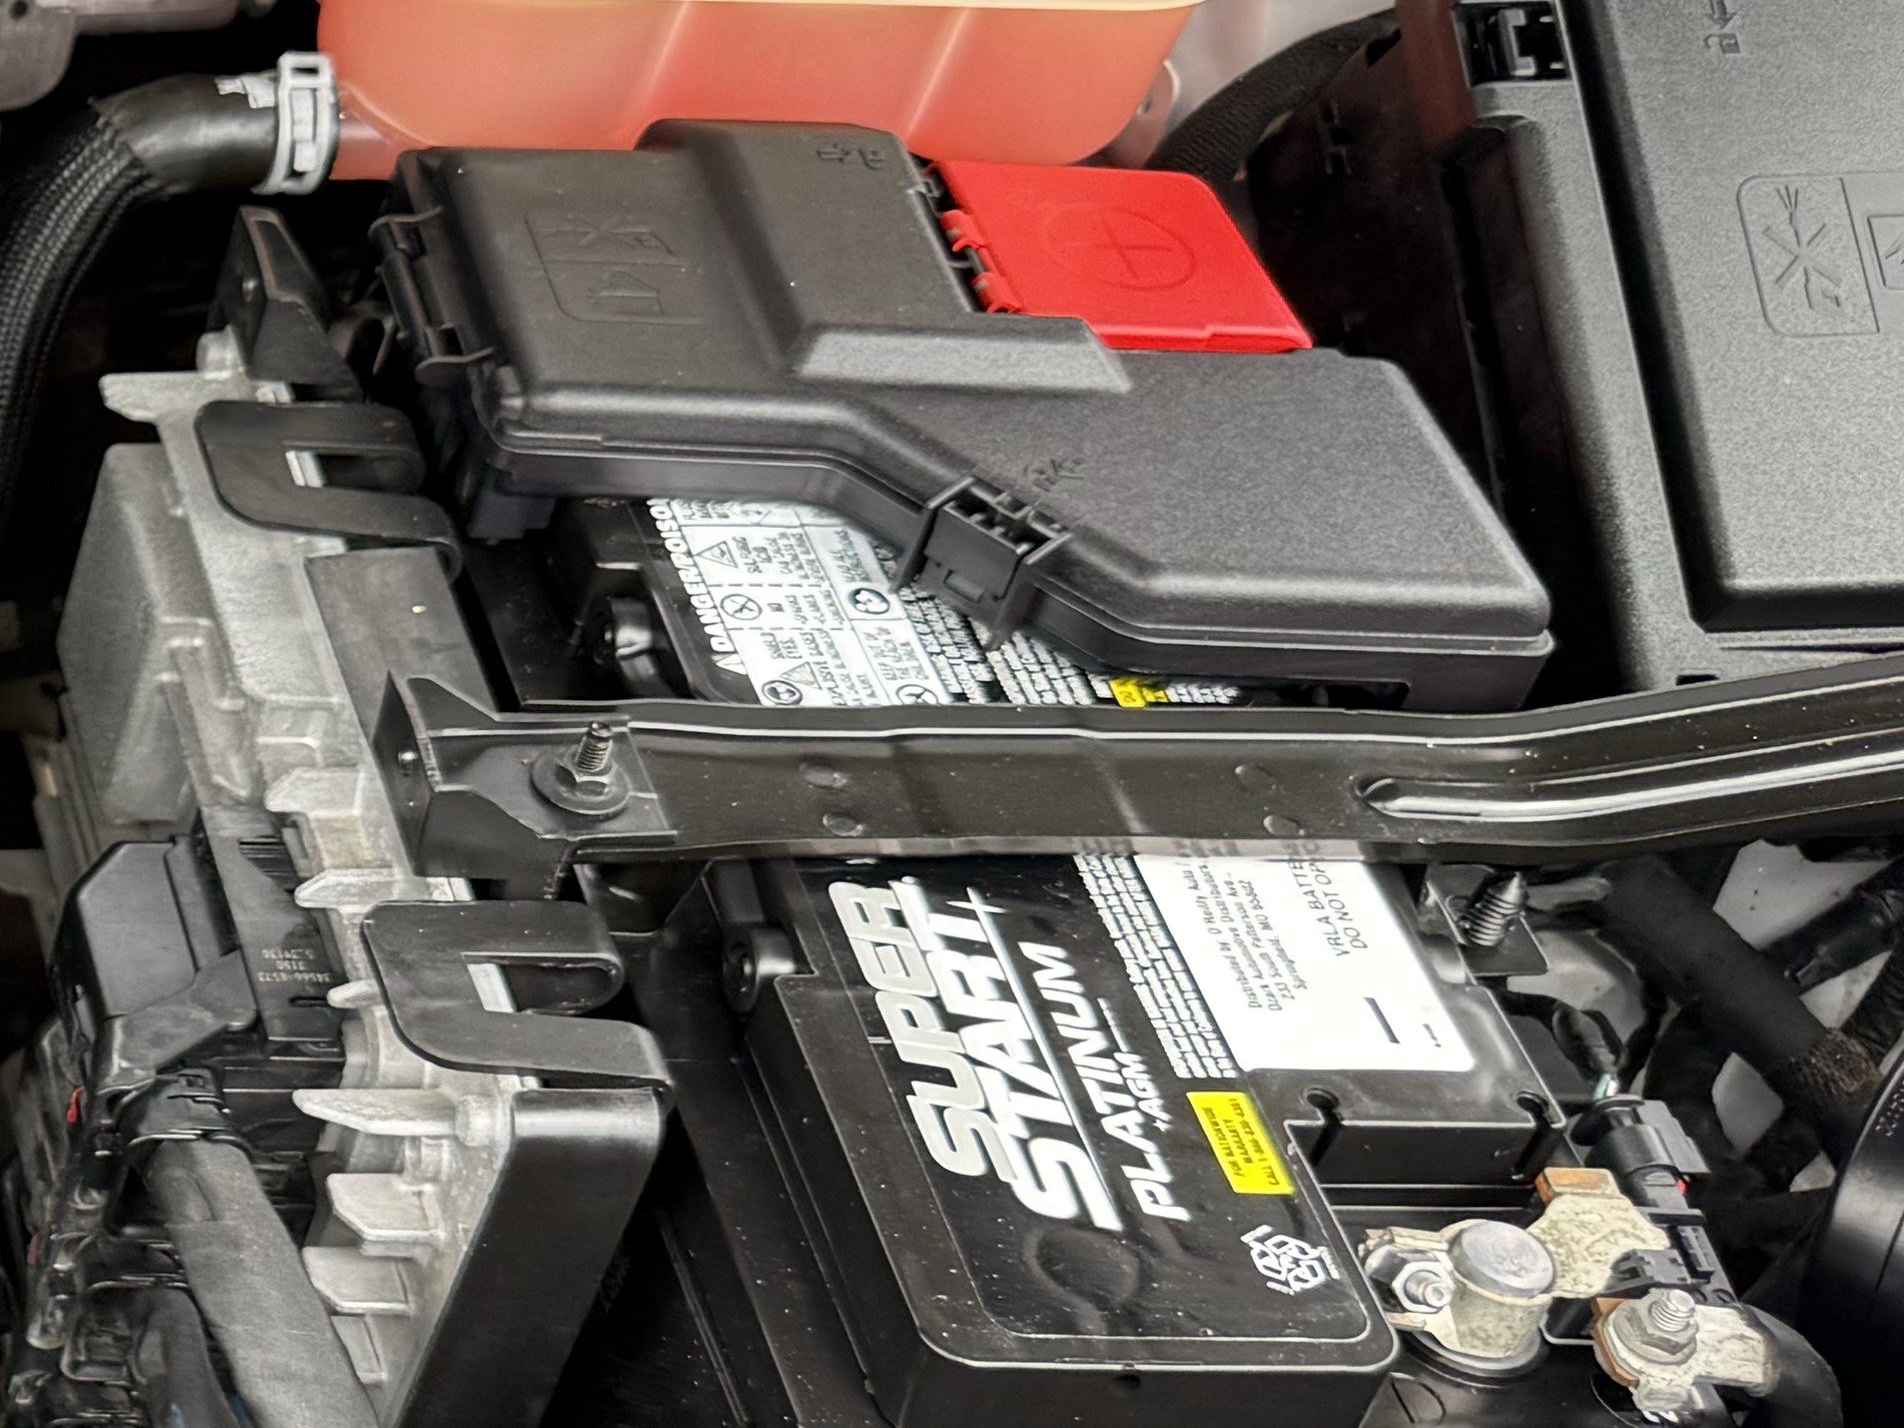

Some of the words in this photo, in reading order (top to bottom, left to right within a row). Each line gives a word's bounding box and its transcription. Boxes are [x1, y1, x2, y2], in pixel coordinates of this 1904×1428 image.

[1286, 860, 1325, 909] BATTE
[1323, 892, 1354, 920] NOT
[1313, 915, 1351, 955] VRLA
[1342, 927, 1369, 948] DO
[828, 880, 1020, 1183] SUPER
[889, 876, 1124, 1232] START
[1018, 941, 1192, 1222] PLATINUM
